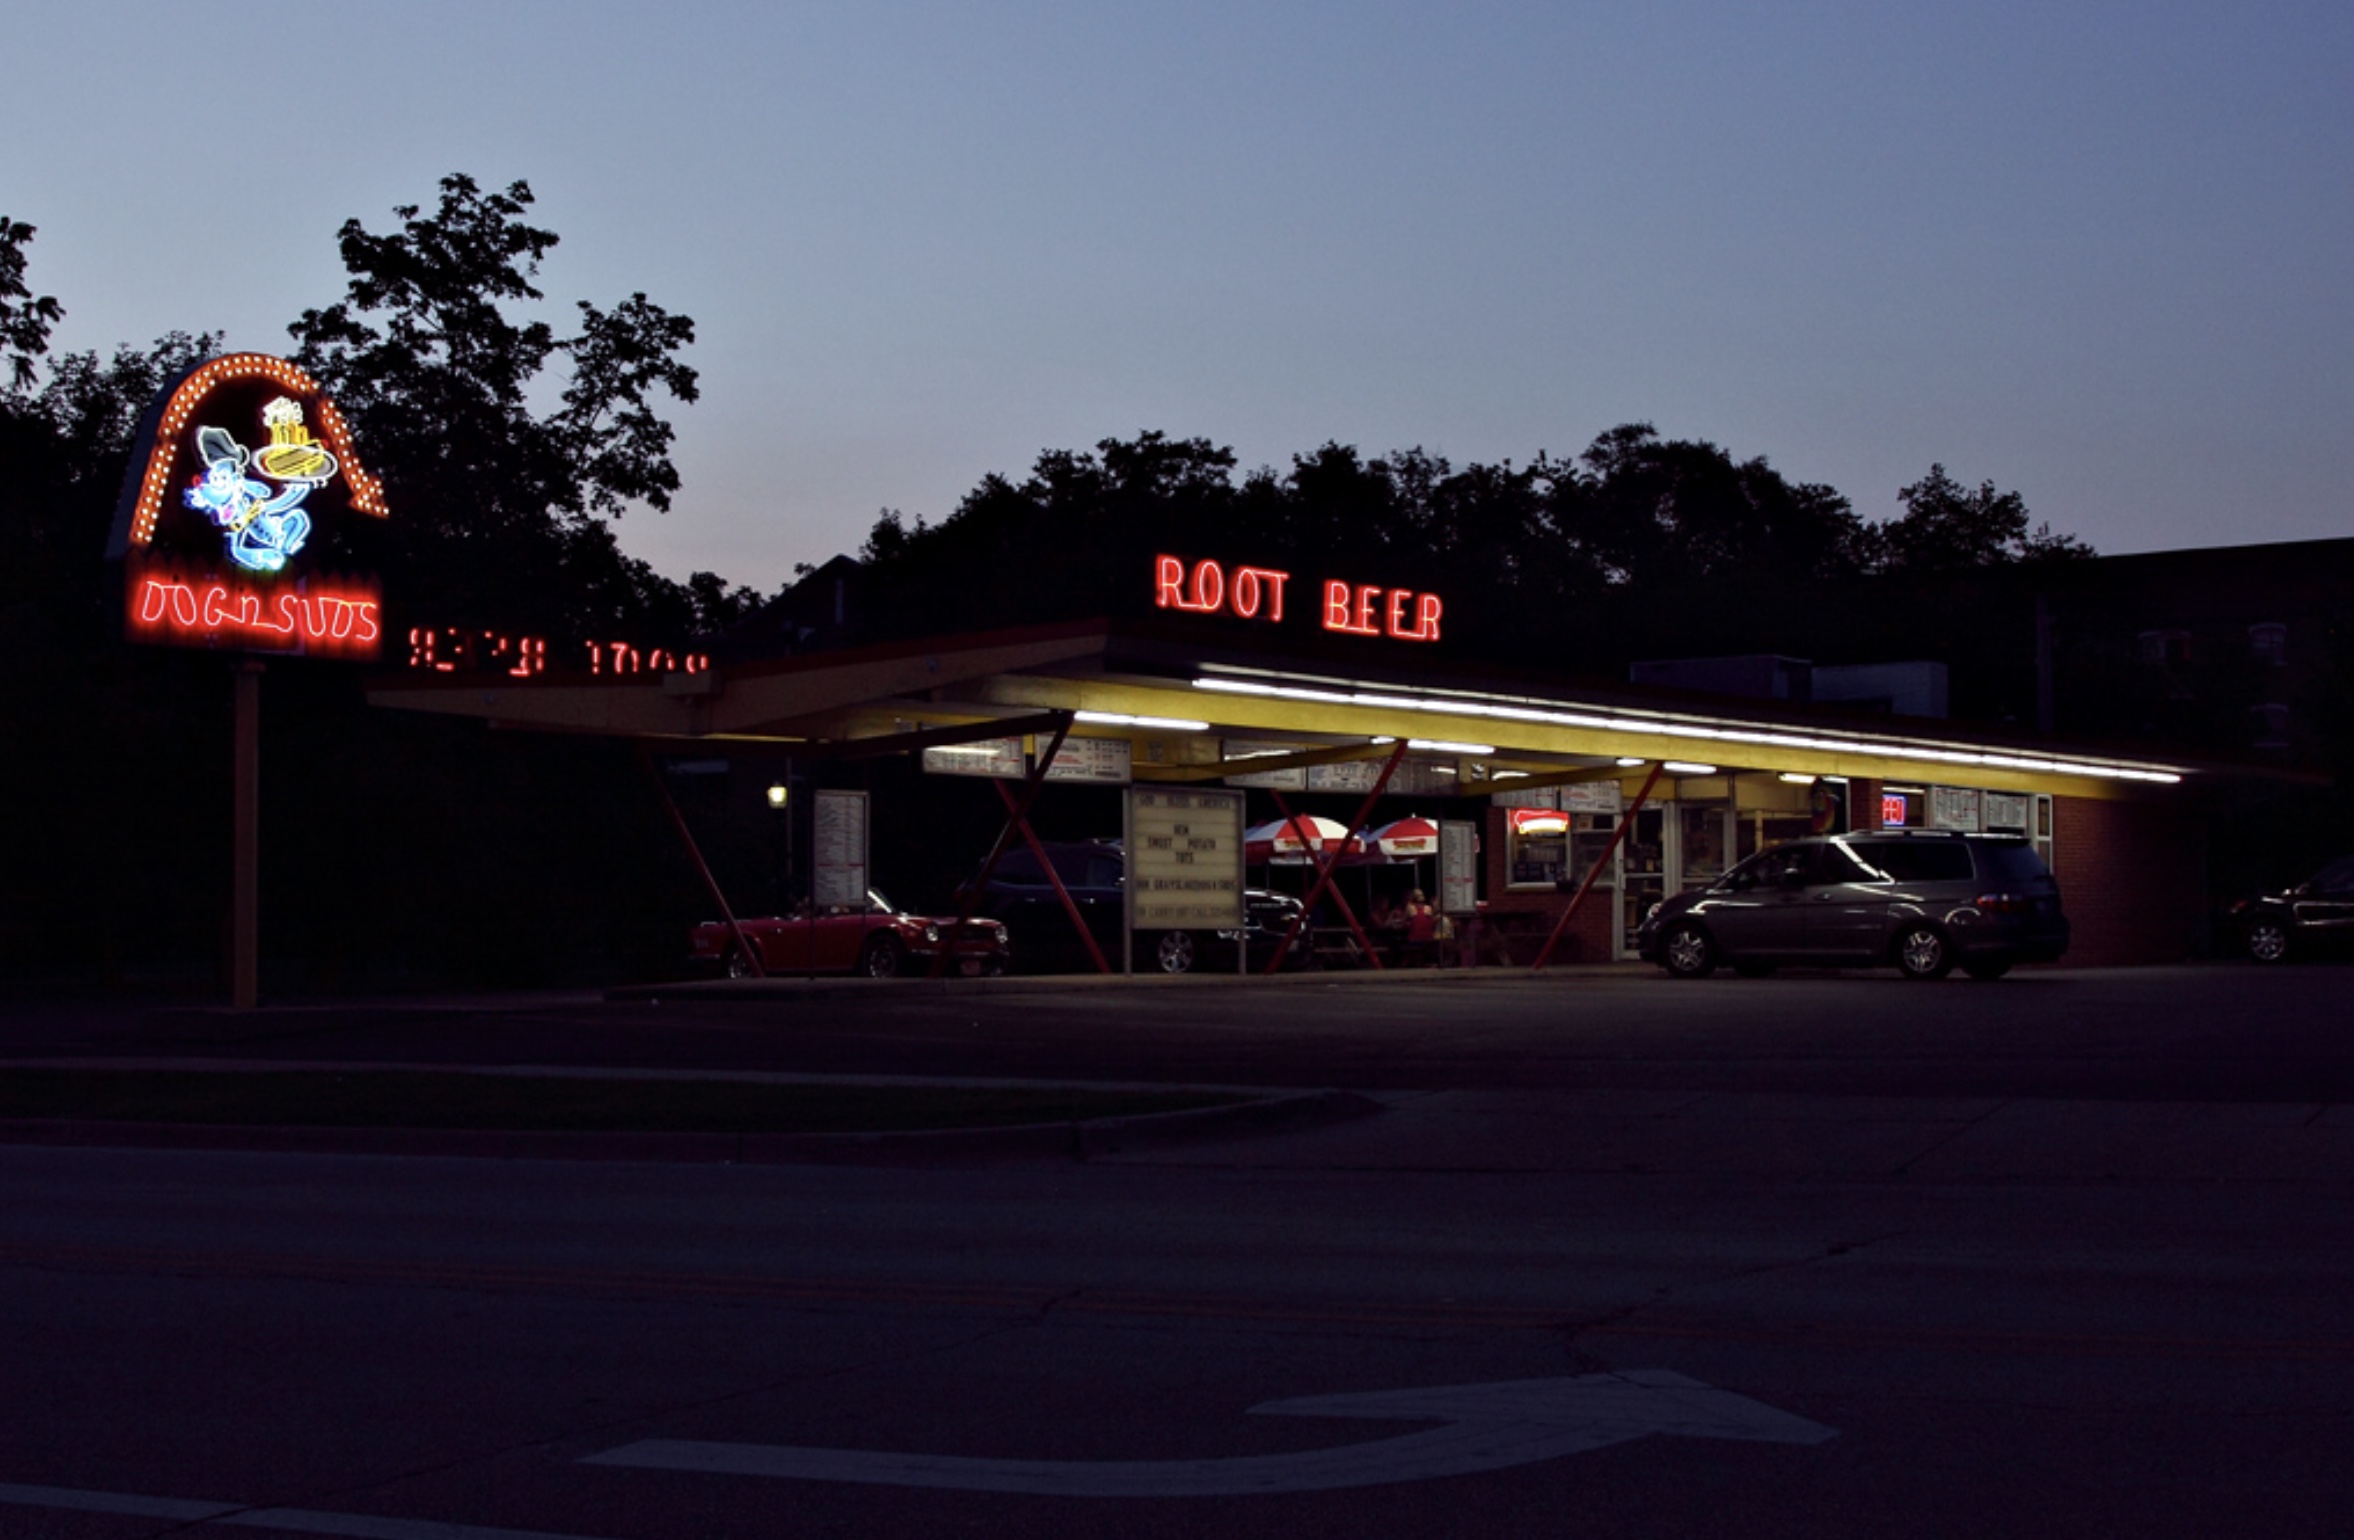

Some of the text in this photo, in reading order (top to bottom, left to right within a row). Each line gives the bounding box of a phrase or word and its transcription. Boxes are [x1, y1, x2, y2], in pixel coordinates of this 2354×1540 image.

[141, 580, 227, 626] DOG
[278, 594, 379, 642] SUDS
[1156, 554, 1442, 641] ROOT BEER
